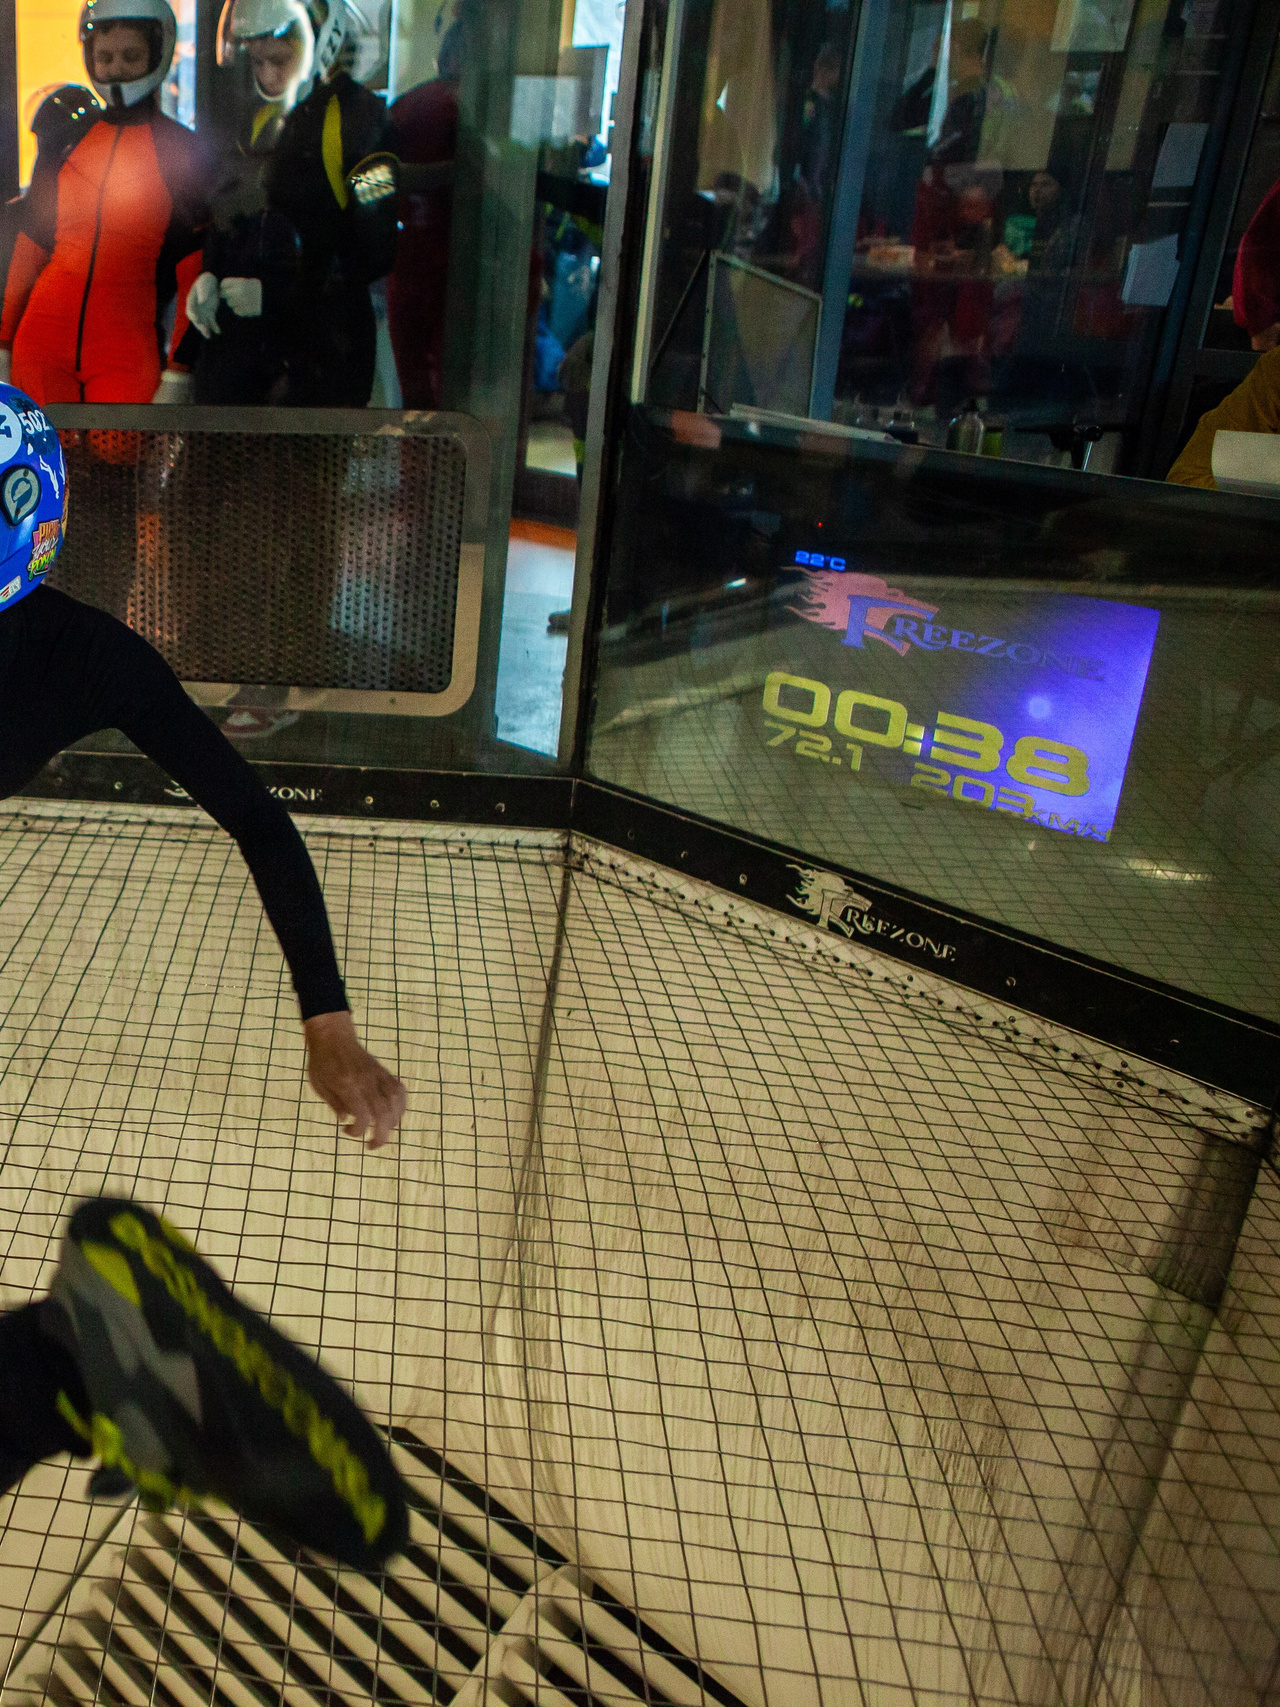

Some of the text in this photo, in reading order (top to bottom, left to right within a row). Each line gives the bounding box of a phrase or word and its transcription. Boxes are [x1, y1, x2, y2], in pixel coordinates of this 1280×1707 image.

[18, 410, 50, 434] 502
[763, 671, 1090, 797] 00:38
[764, 720, 863, 772] 72.1
